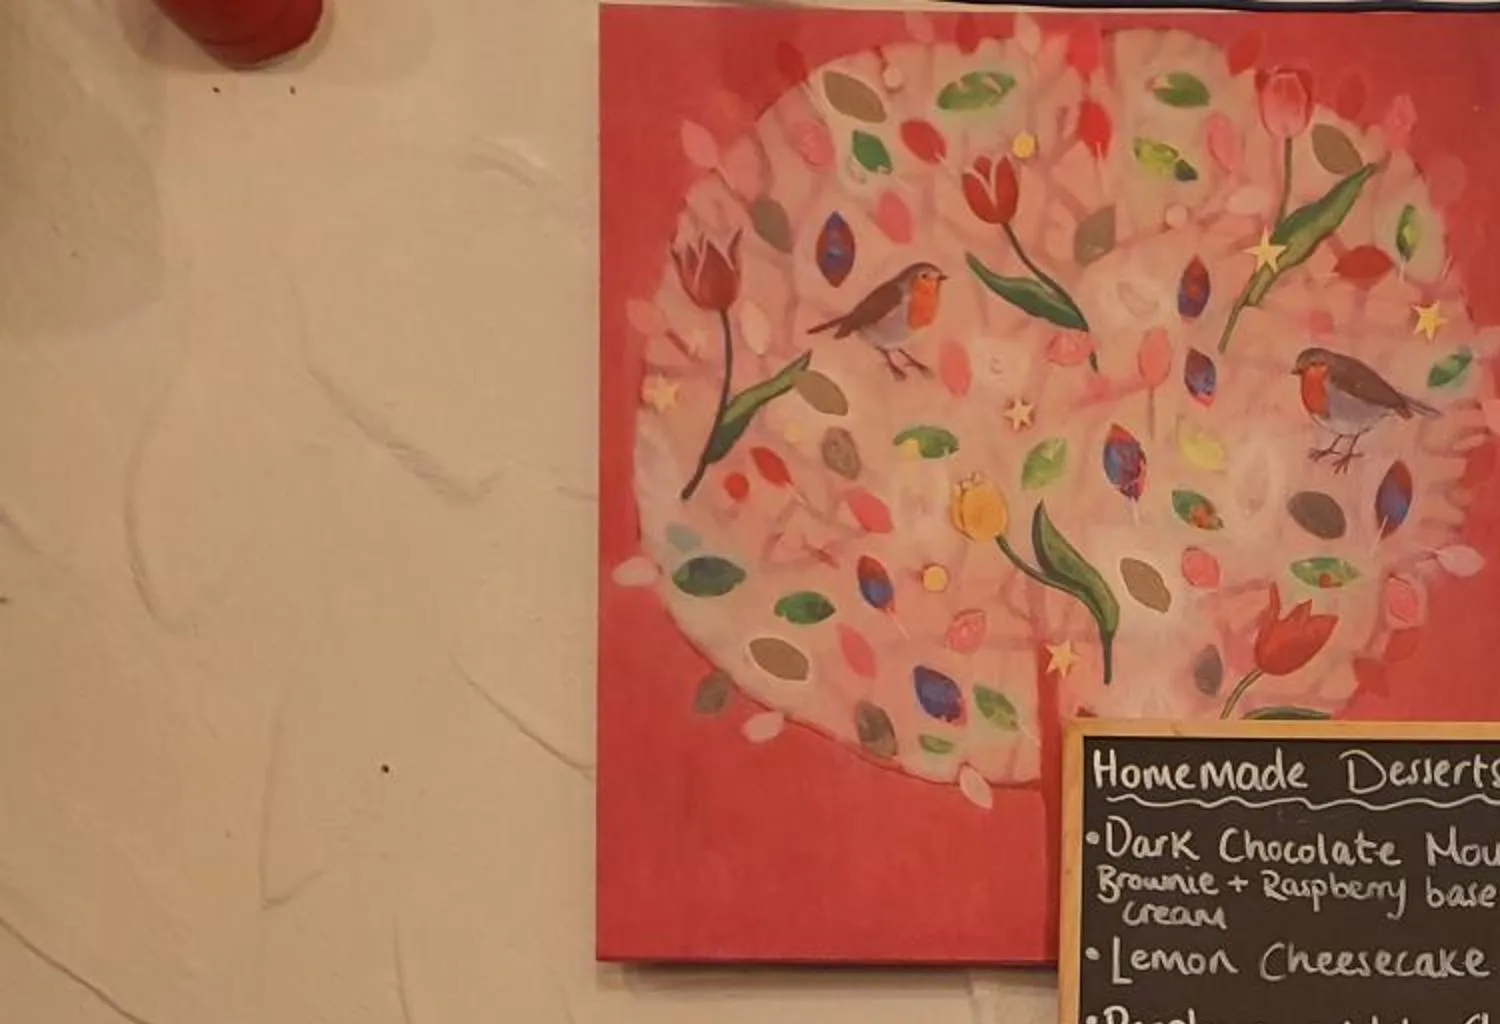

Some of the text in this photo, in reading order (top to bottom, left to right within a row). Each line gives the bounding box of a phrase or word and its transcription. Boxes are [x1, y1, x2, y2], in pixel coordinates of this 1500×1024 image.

[1092, 747, 1309, 793] Homemade
[1105, 814, 1201, 862] Dark
[1219, 826, 1402, 867] Chocolate
[1096, 863, 1220, 904] Brownie
[1260, 869, 1407, 920] Raspberry
[1426, 876, 1497, 908] base
[1121, 900, 1228, 931] cream
[1112, 935, 1491, 985] Lemon Cheesecake
